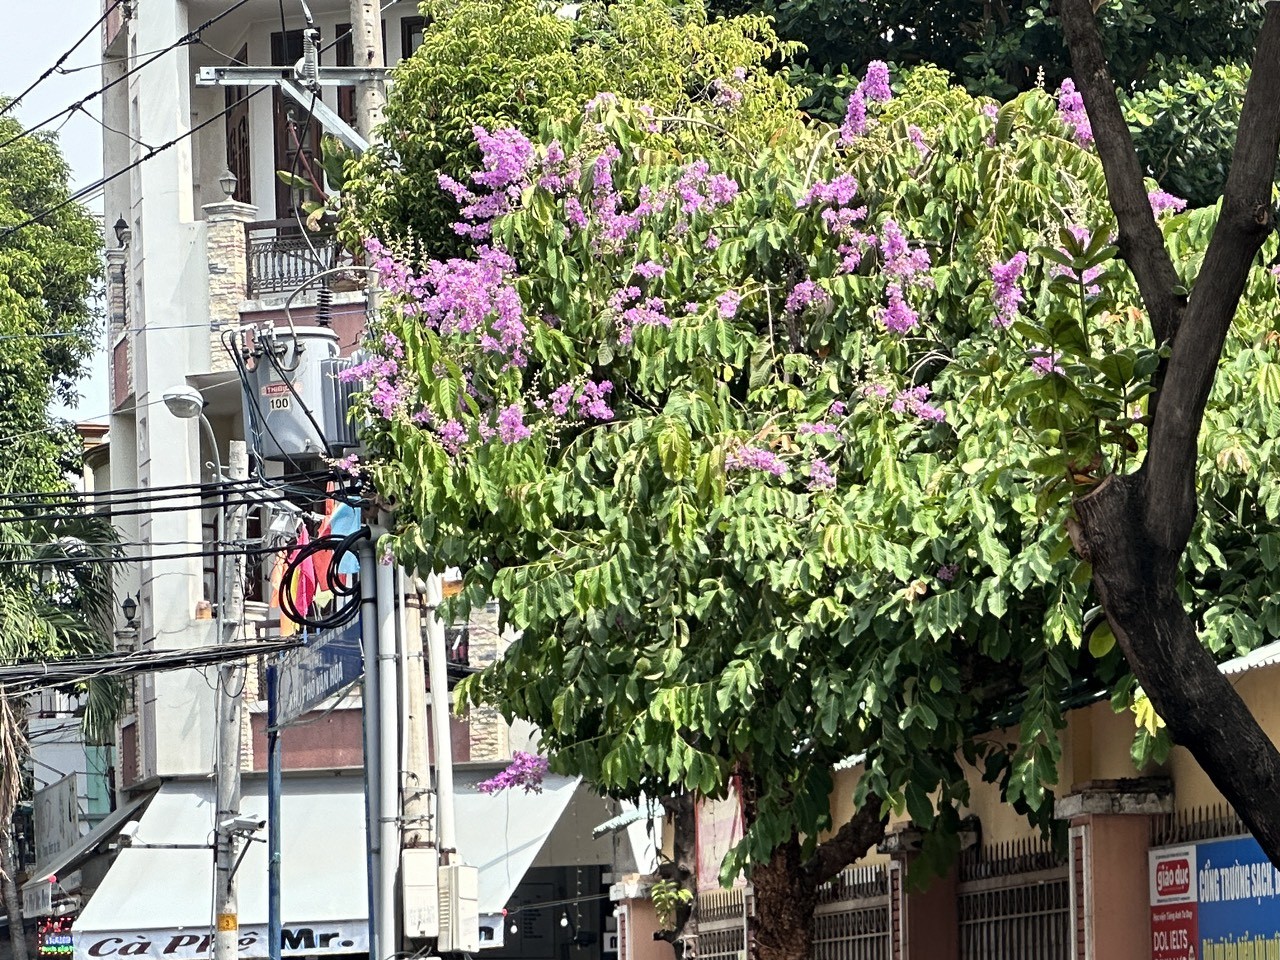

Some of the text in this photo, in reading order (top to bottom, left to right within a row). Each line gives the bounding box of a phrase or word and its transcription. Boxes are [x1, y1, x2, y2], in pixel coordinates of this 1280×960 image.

[271, 398, 288, 409] 100
[1157, 864, 1188, 891] giáo dục
[1199, 859, 1219, 903] CỔNG
[1220, 859, 1251, 901] TRƯỜNG
[1251, 861, 1274, 906] SẠCH,
[88, 935, 152, 957] Cà
[281, 928, 354, 950] Mr.
[1154, 929, 1188, 951] DOL IELTS
